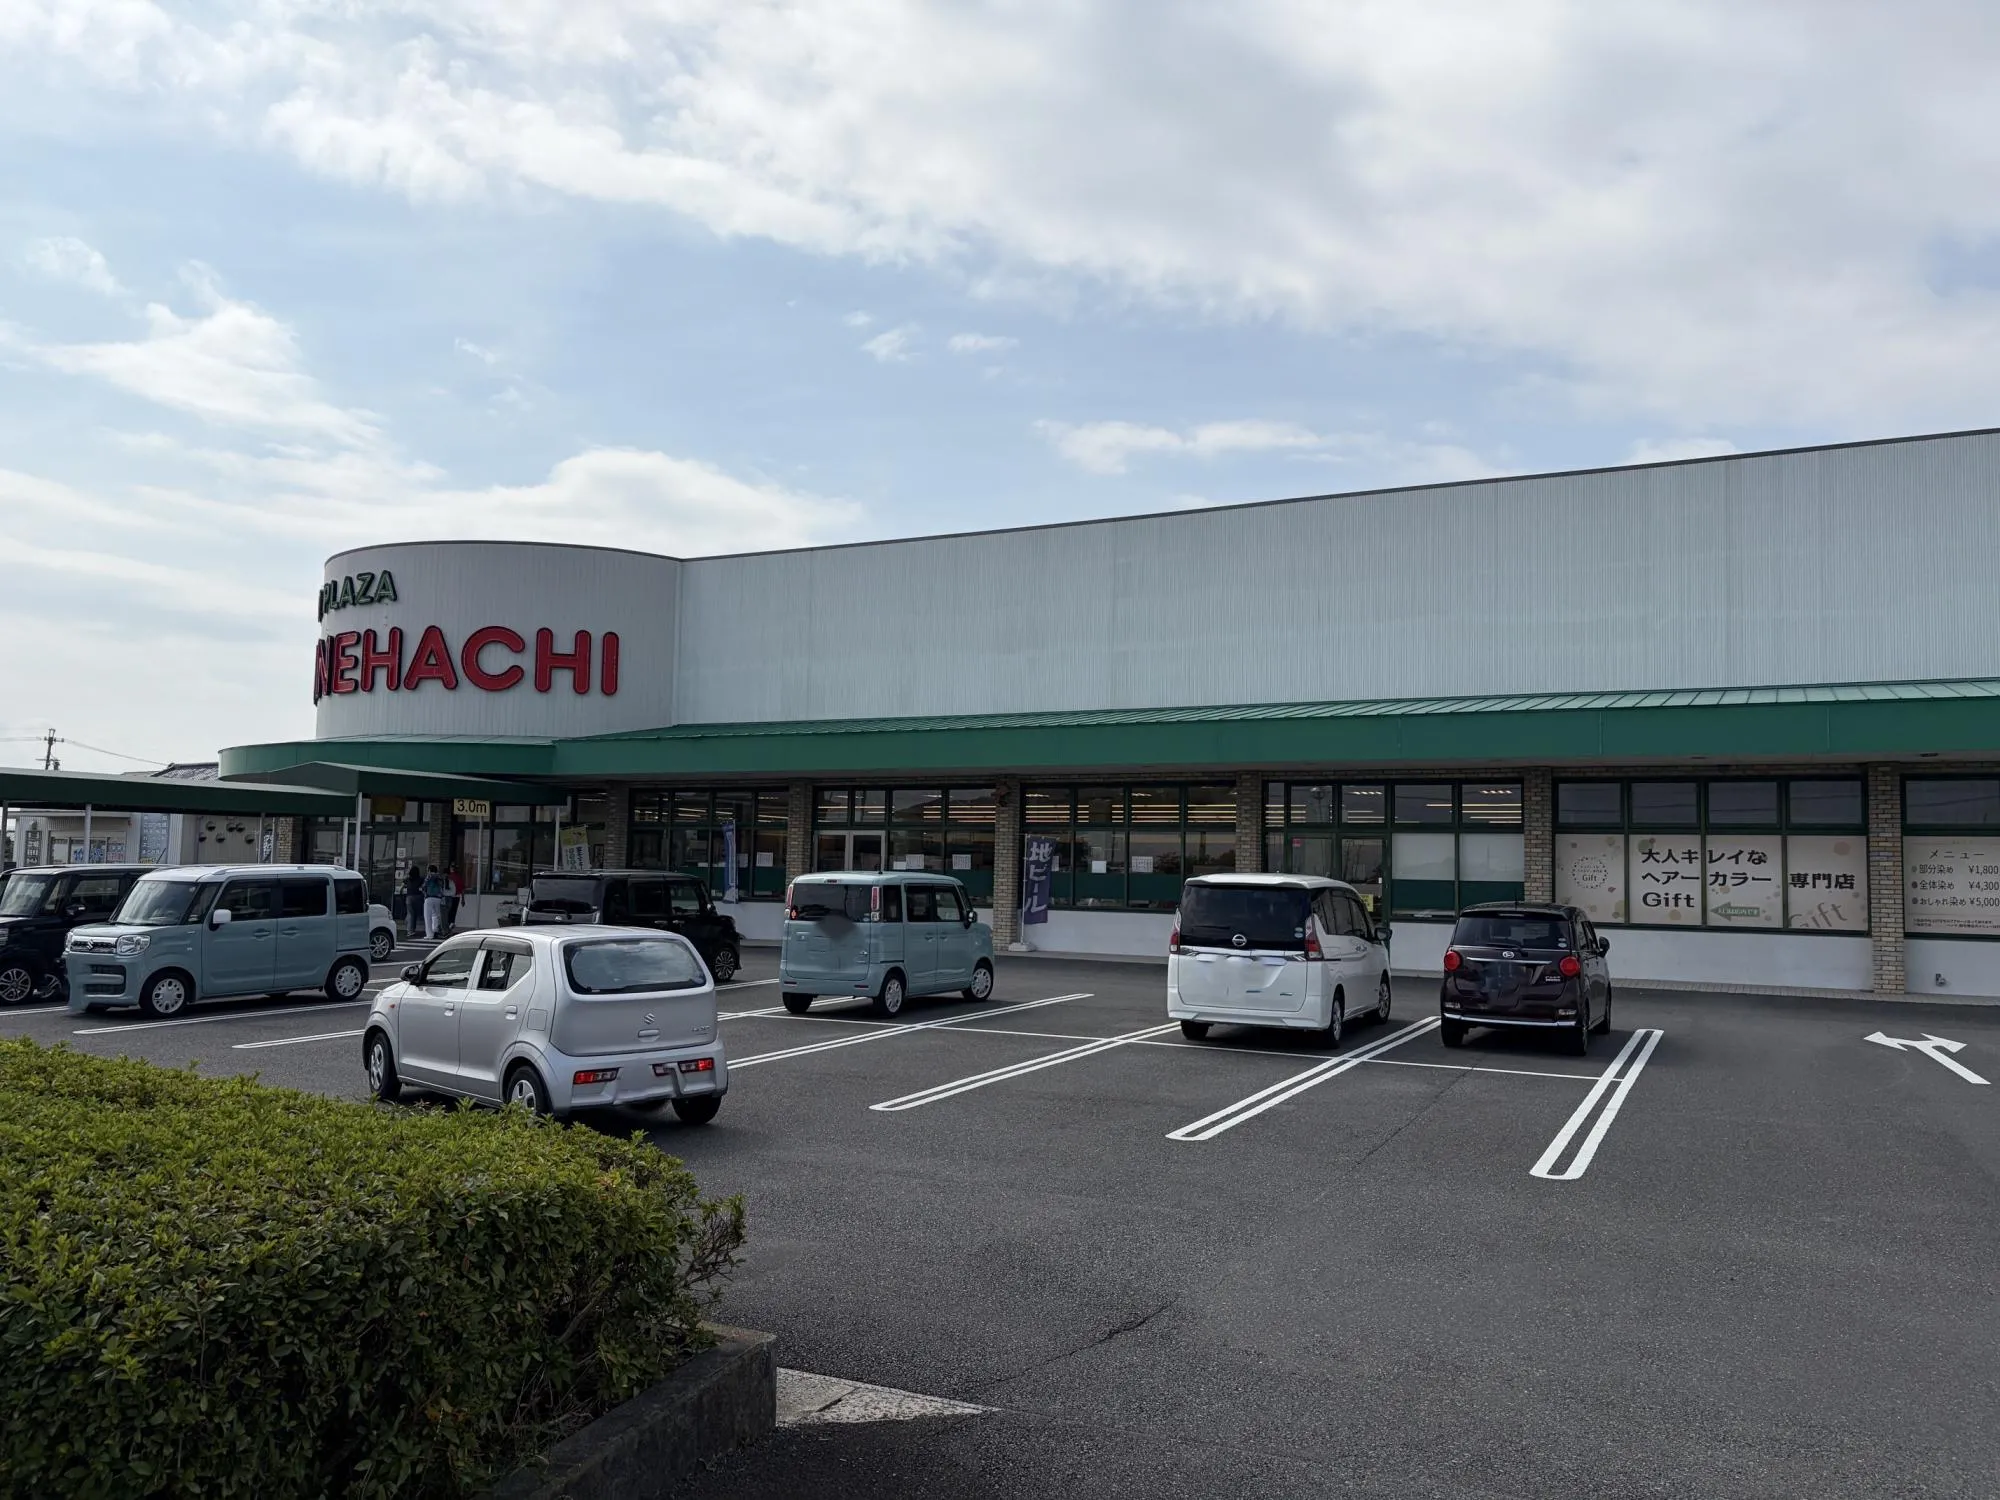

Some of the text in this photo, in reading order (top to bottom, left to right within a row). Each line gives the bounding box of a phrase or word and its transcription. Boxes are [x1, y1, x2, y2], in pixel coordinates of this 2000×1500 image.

[323, 570, 398, 614] PLAZA
[456, 799, 487, 814] 3.0m
[1929, 850, 1985, 859] メニュー
[1919, 864, 1999, 875] 部分染め ¥1,800
[1024, 841, 1053, 913] 地ビール
[1582, 874, 1598, 882] Gift
[1919, 880, 2000, 892] 全体染め ¥4,300
[1642, 892, 1695, 908] Gift
